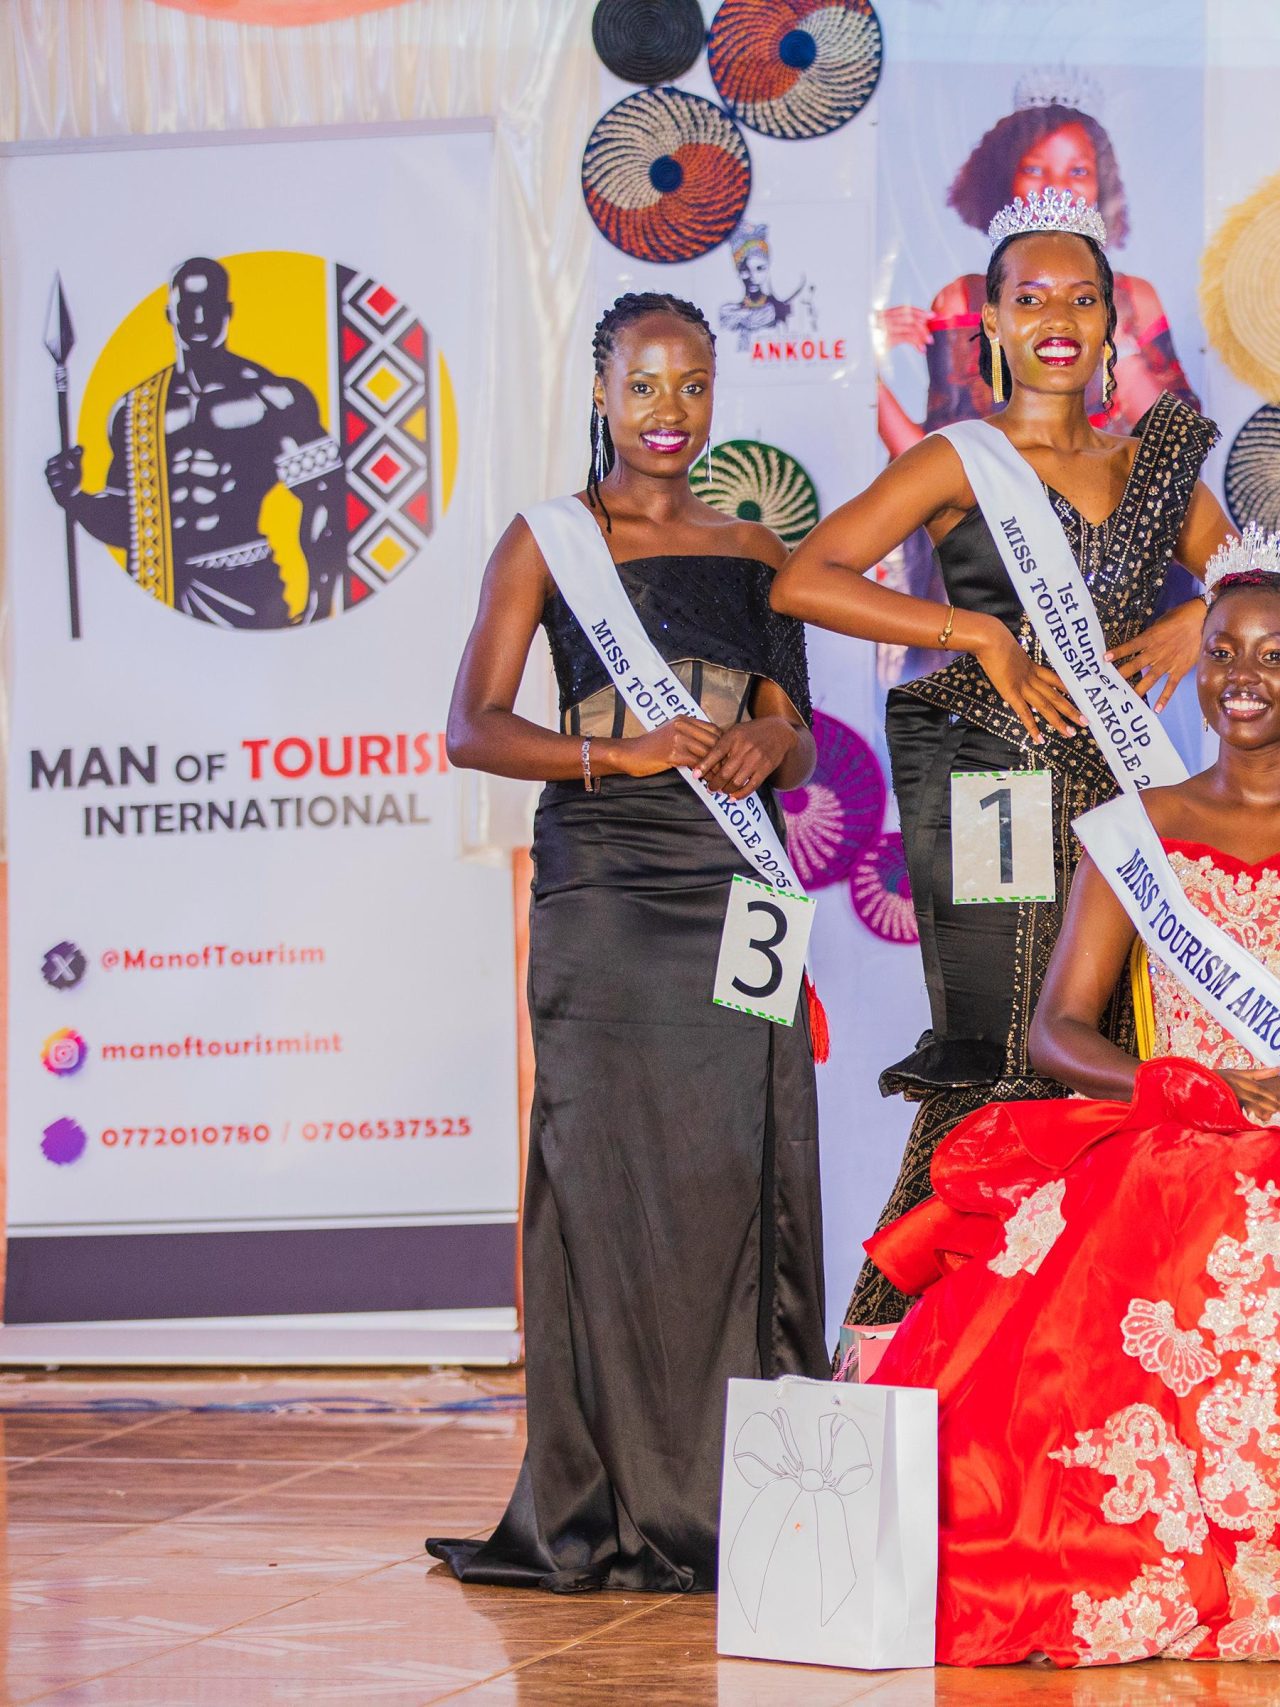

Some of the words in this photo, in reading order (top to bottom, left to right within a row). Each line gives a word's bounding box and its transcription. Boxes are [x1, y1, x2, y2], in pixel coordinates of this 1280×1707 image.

[752, 340, 846, 361] ANKOLE
[1000, 516, 1037, 575] MISS
[1030, 577, 1092, 683] TOURISM
[1084, 687, 1141, 772] ANKOLE
[1057, 581, 1079, 614] 1st
[1130, 715, 1151, 748] Up
[30, 744, 157, 791] MAN
[175, 753, 227, 784] OF
[242, 732, 449, 781] TOURIS
[591, 618, 630, 675] MISS
[698, 777, 761, 849] KOLE
[754, 849, 792, 888] 2025
[84, 793, 431, 838] INTERNATIONAL
[979, 788, 1013, 884] 1
[101, 943, 325, 970] @ManofTourism
[731, 900, 788, 998] 3
[1115, 848, 1161, 912] MISS
[1149, 899, 1241, 1001] TOURISM
[101, 1033, 342, 1061] manoftourismint
[101, 1123, 270, 1147] 0772010780
[302, 1117, 472, 1141] 0706537525
